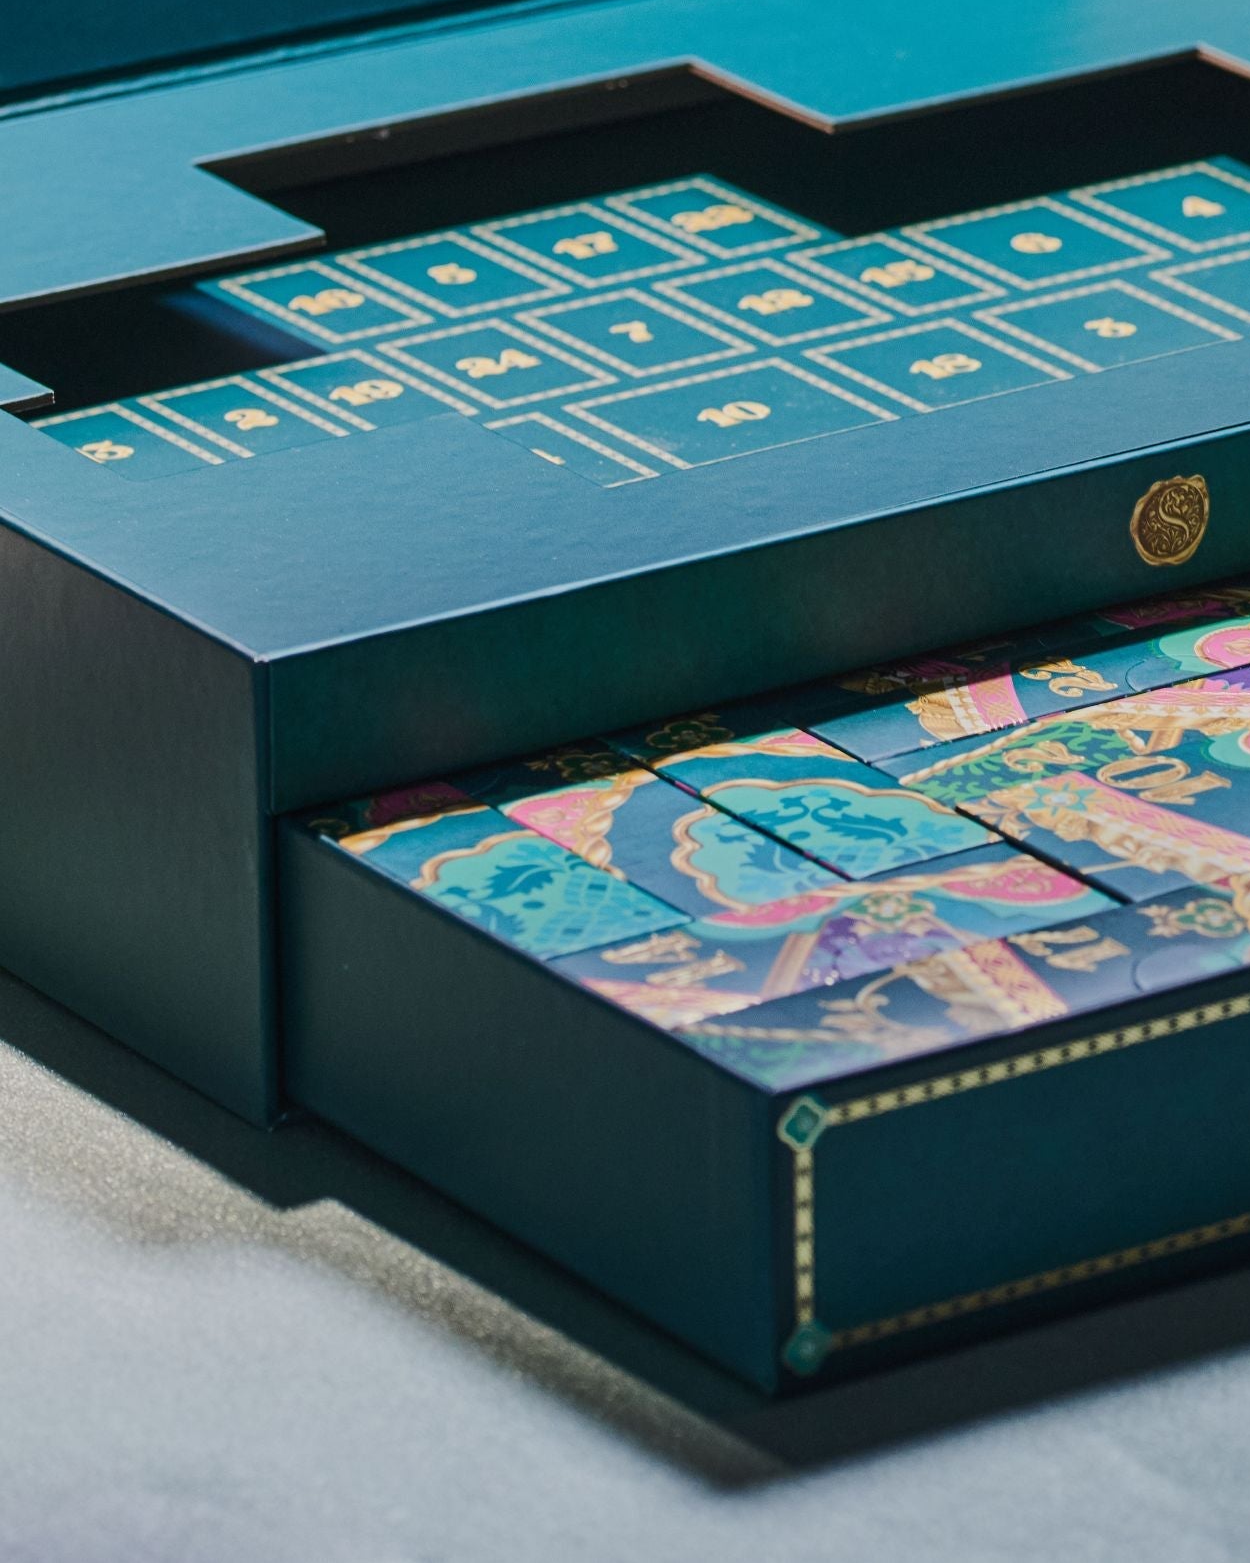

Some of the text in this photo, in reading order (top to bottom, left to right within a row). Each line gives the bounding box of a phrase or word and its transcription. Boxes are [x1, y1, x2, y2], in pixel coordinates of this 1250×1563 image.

[553, 231, 619, 260] 17
[609, 319, 655, 344] 7
[455, 348, 543, 379] 24
[328, 379, 405, 406] 19
[223, 408, 279, 431] 2
[696, 401, 772, 428] 10
[1096, 755, 1232, 806] 10
